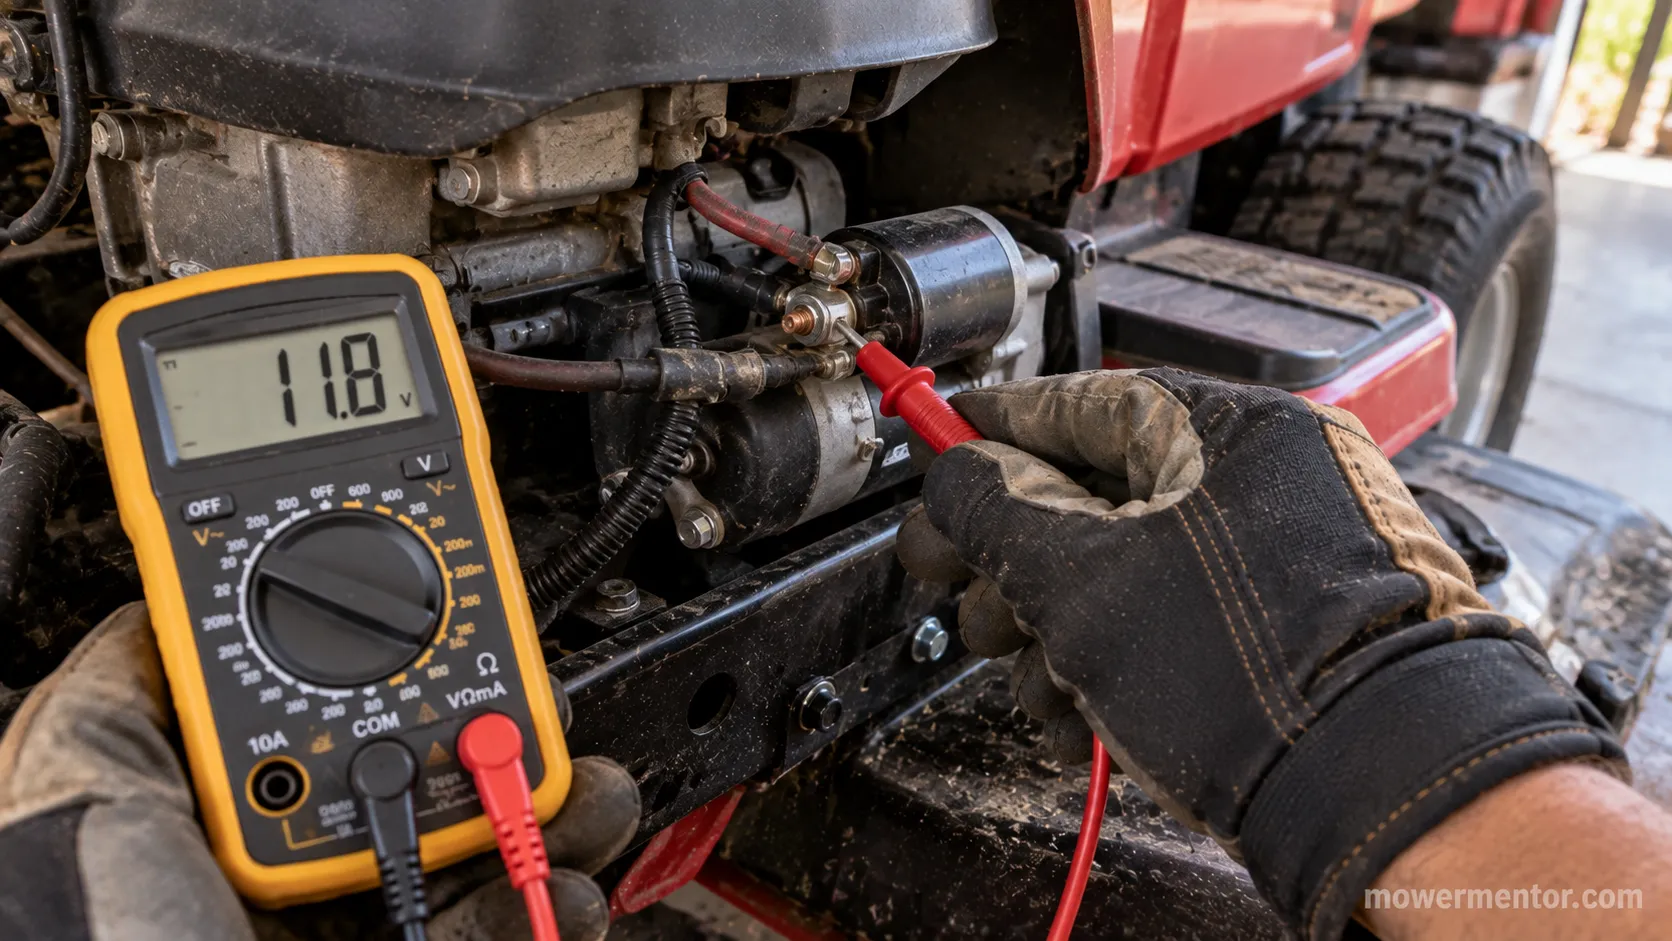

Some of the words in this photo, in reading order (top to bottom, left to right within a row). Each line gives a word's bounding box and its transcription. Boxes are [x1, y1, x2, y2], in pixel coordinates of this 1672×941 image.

[278, 332, 386, 427] 11.8
[400, 392, 412, 407] V
[416, 454, 431, 472] V
[310, 484, 335, 499] OFF
[188, 497, 221, 518] OFF
[276, 496, 299, 511] 200
[245, 514, 269, 529] 200
[220, 555, 237, 570] 20
[476, 652, 499, 676] Ω
[445, 680, 507, 709] VΩmA
[352, 711, 401, 738] COM
[247, 730, 289, 756] 10A
